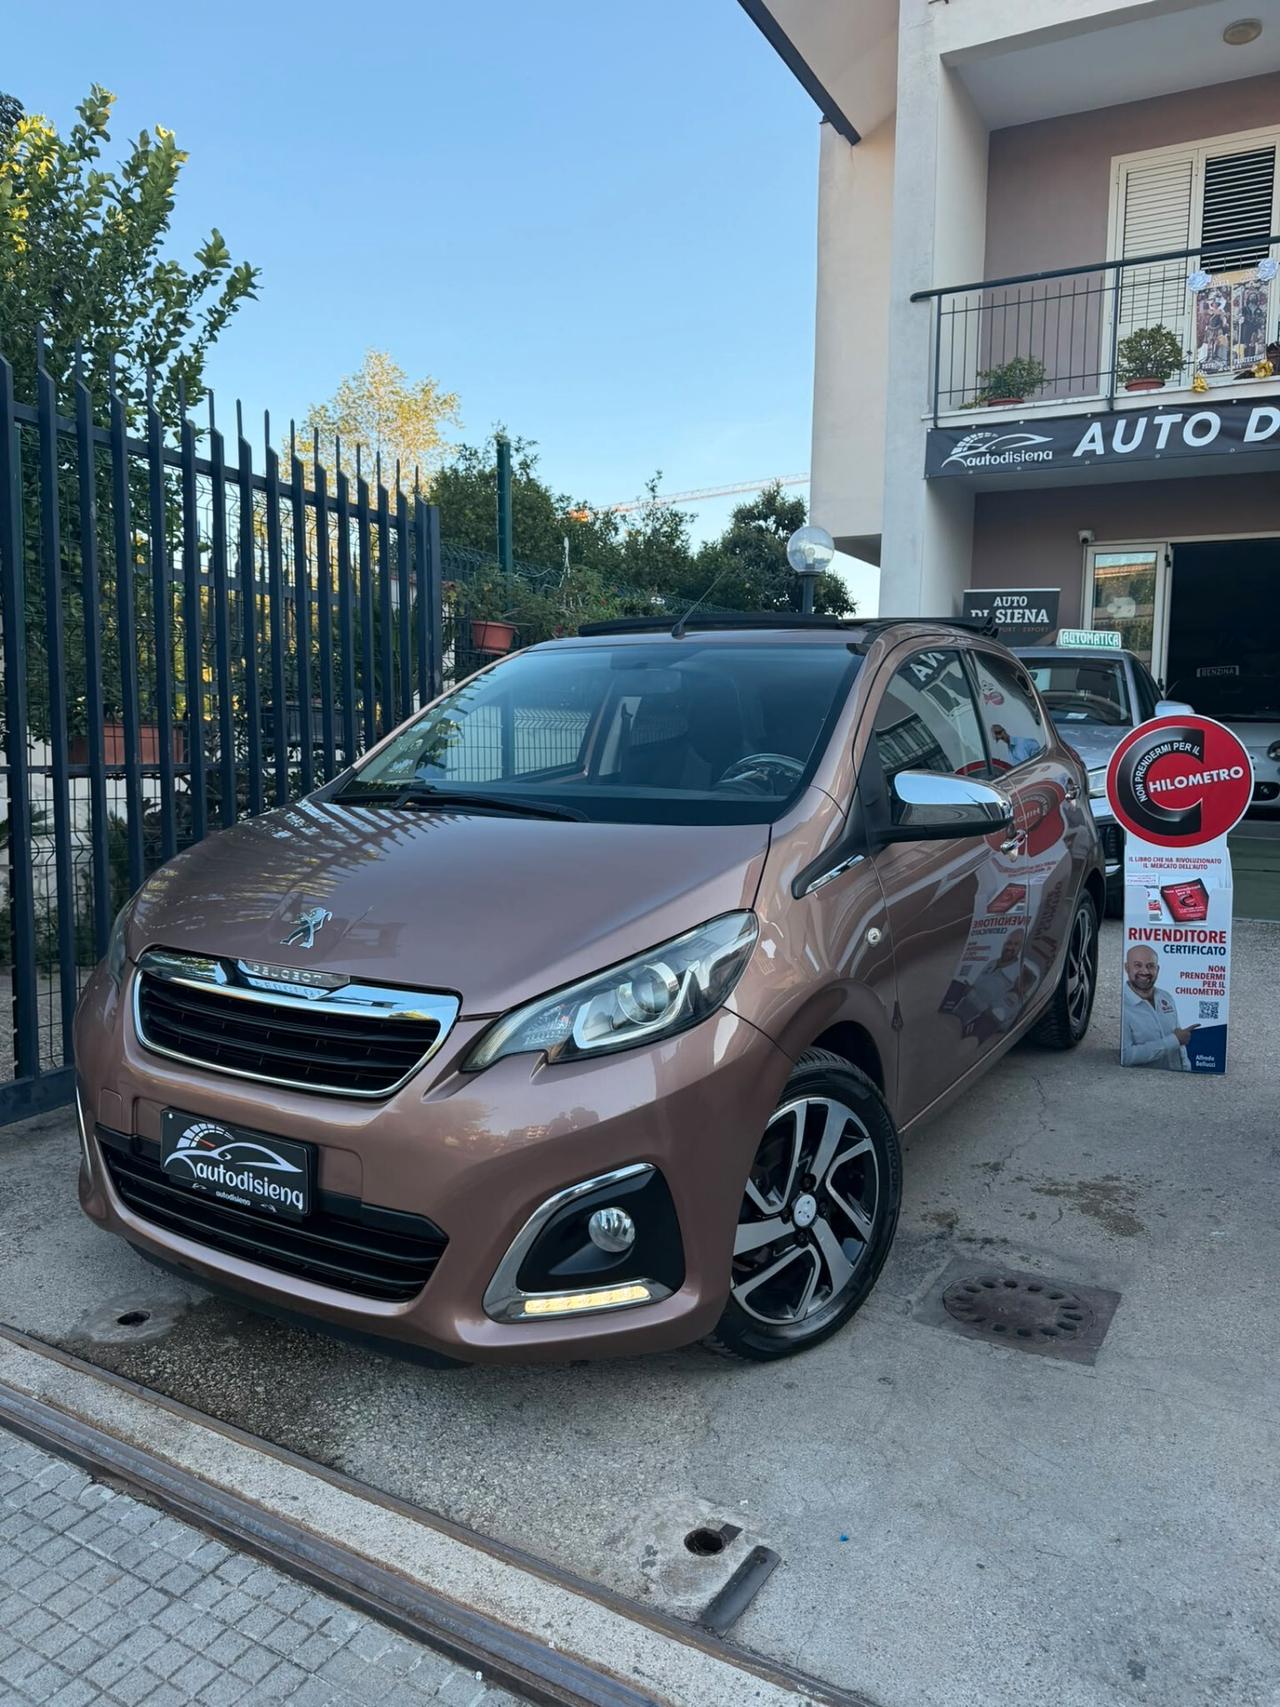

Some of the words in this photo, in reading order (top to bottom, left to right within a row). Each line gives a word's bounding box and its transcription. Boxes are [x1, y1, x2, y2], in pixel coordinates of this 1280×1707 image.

[1072, 411, 1221, 457] AUTO
[966, 449, 1053, 467] autodisiena
[993, 595, 1028, 607] AUTO
[995, 608, 1050, 624] SIENA
[1063, 631, 1120, 647] AUTOMATICA
[1173, 742, 1191, 752] PER
[1192, 744, 1201, 756] IL
[1135, 743, 1172, 783] PRENDERMI
[1135, 785, 1148, 803] NON
[1175, 857, 1222, 865] RIVOLUZIONATO
[1128, 927, 1227, 944] RIVENDITORE
[1163, 944, 1226, 956] CERTIFICATO
[252, 964, 322, 984] PEUGEOT
[1179, 972, 1226, 981] PRENDERMI
[1208, 965, 1226, 973] NON
[1175, 986, 1226, 997] CHILOMETRO
[1202, 980, 1218, 988] PER
[1218, 981, 1226, 989] IL
[196, 1162, 303, 1211] autodisiena
[215, 1190, 252, 1206] autodisiena
